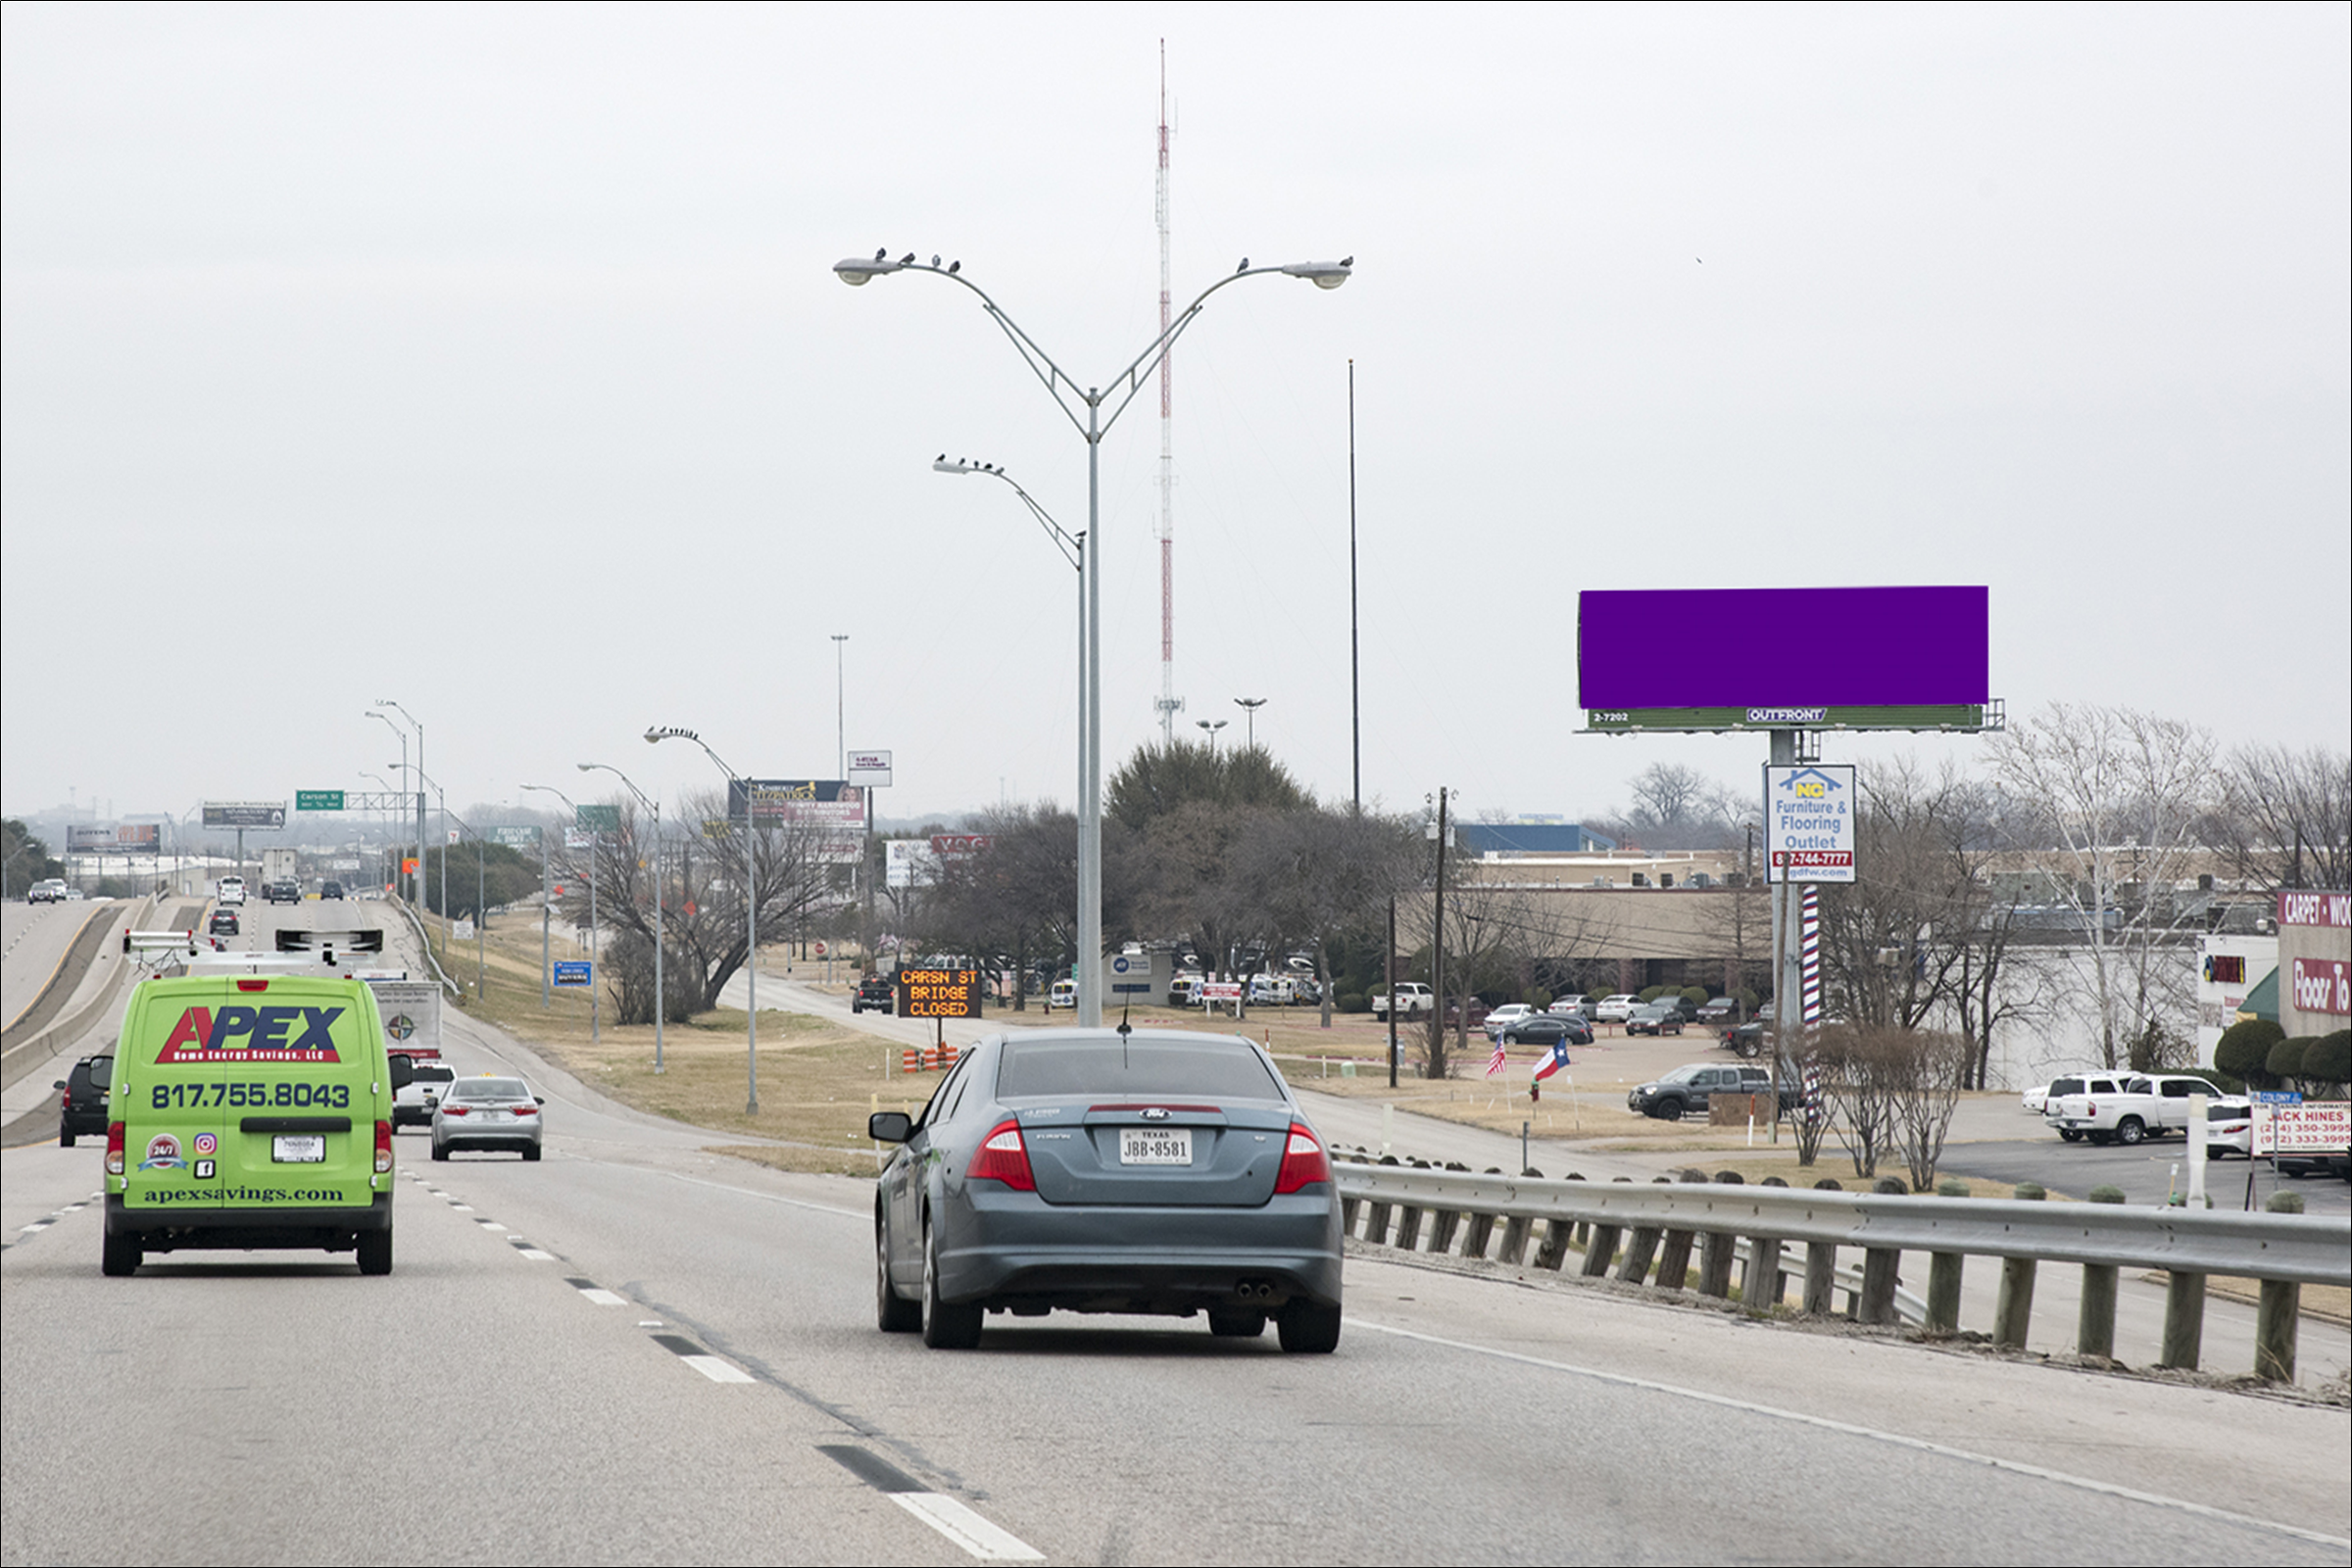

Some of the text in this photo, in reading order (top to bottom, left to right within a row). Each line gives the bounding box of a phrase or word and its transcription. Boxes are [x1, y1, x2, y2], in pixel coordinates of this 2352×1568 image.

[1593, 712, 1628, 721] 2-7202
[1749, 709, 1823, 720] OUTFRONT
[1796, 783, 1824, 798] NG
[1776, 800, 1846, 813] Furniture &
[1781, 815, 1841, 833] Flooring
[1785, 835, 1837, 849] Outlet
[1776, 853, 1848, 864] 87-744-7777
[1781, 868, 1847, 878] gdfw.com
[2285, 894, 2321, 924] CARPET
[901, 970, 977, 984] CARSN ST
[910, 986, 968, 1000] BRIDGE
[2333, 963, 2349, 1011] To
[910, 1002, 968, 1015] CLOSED
[155, 1006, 346, 1052] APEX
[173, 1051, 204, 1060] Home
[208, 1051, 248, 1061] Energy
[306, 1051, 323, 1060] LLC
[152, 1083, 350, 1108] 817.755.8043
[2262, 1092, 2291, 1102] COLONY
[2268, 1111, 2344, 1122] JACK HINES
[2260, 1124, 2351, 1134] (24) 350-3995
[2260, 1135, 2351, 1145] (92) 333-3995
[154, 1146, 173, 1155] 24/7
[145, 1185, 344, 1204] apexsavings.com
